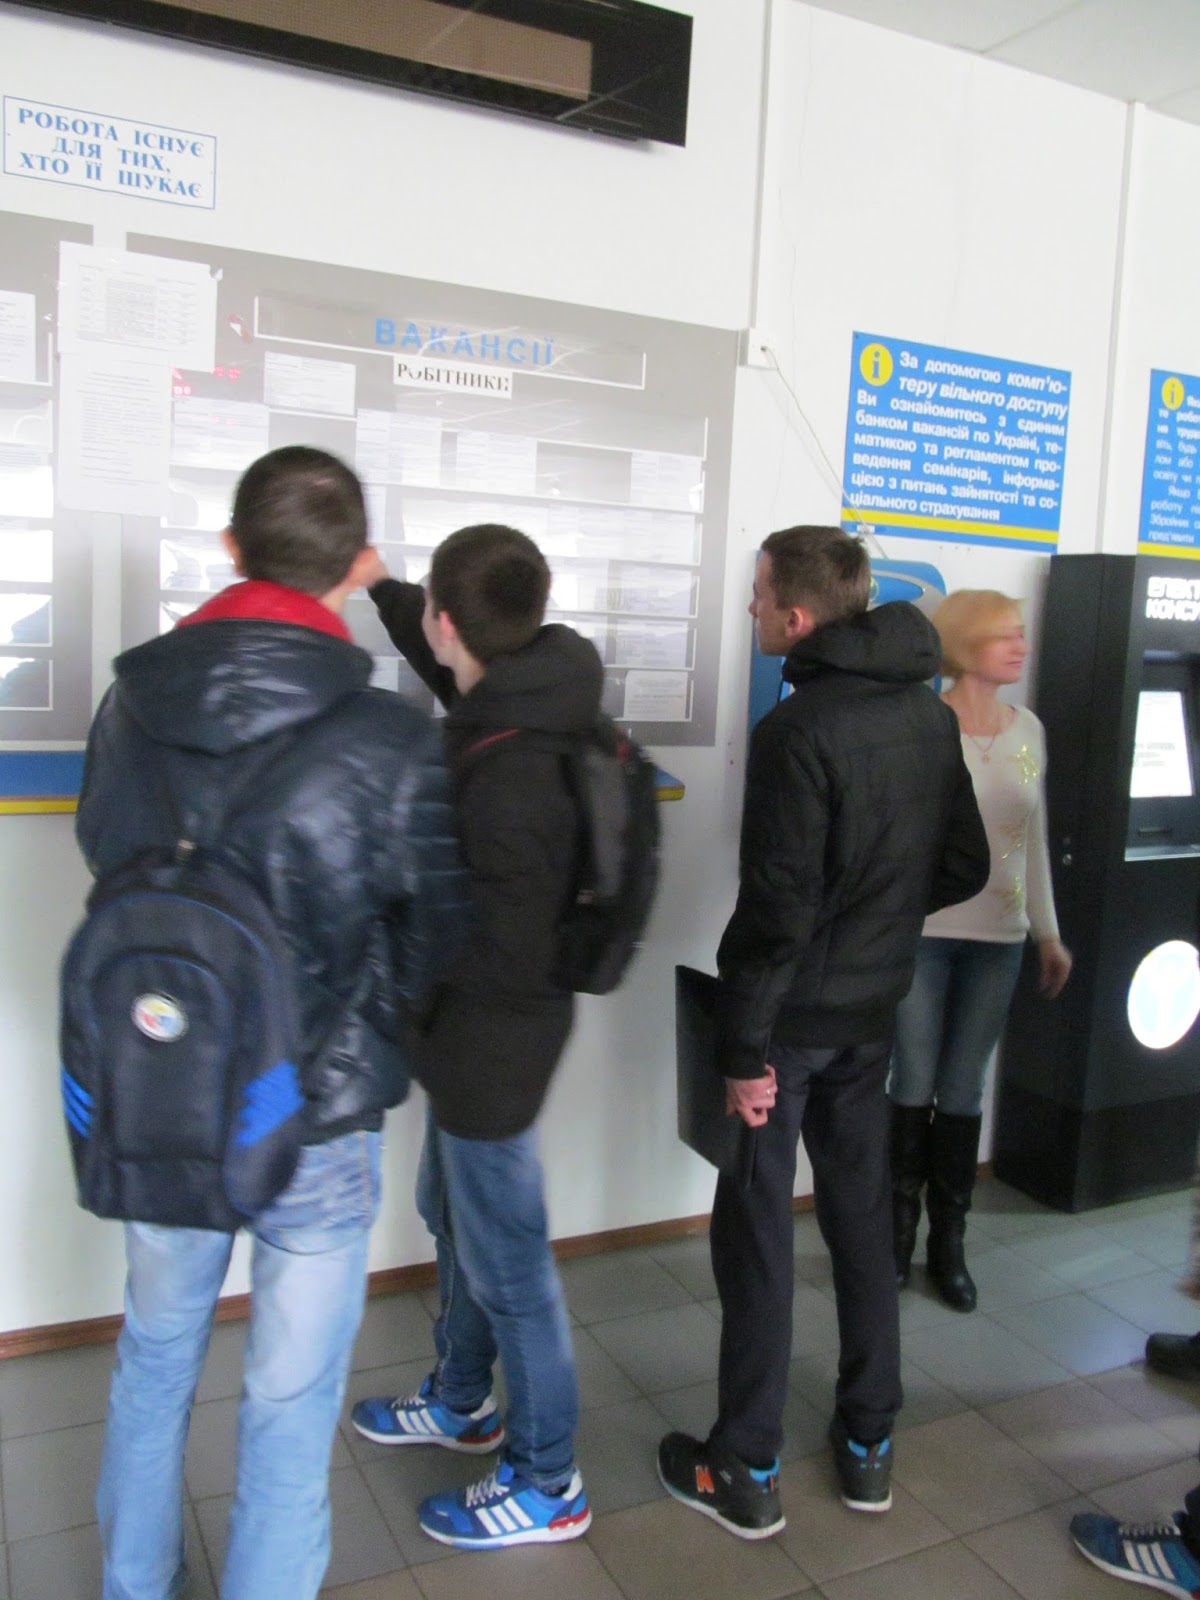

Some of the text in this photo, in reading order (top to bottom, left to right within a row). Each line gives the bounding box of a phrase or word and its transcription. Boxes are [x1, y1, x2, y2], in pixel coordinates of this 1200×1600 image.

[18, 107, 204, 157] РОБОТА ІСНУЄ
[20, 152, 202, 198] ХТО ЇЇ ШУКАЄ
[52, 137, 171, 173] ДЛЯ ТИХ,
[375, 318, 554, 367] ВАКАНСІЇ
[900, 350, 1067, 394] За допомогою комп'ю-
[857, 390, 876, 406] Ви
[890, 399, 986, 425] ознайомитесь
[999, 415, 1005, 427] з
[899, 376, 1068, 421] теру вільного доступу
[854, 433, 1061, 472] матикою та регламентом про-
[856, 410, 1062, 454] банком вакансій по Україні, те-
[851, 473, 884, 490] цією
[889, 477, 896, 489] з
[902, 480, 947, 496] питань
[951, 485, 1019, 504] зайнятості
[1023, 494, 1035, 506] та
[853, 453, 1059, 491] ведення семінарів, інформа-
[850, 493, 999, 520] ціального страхування
